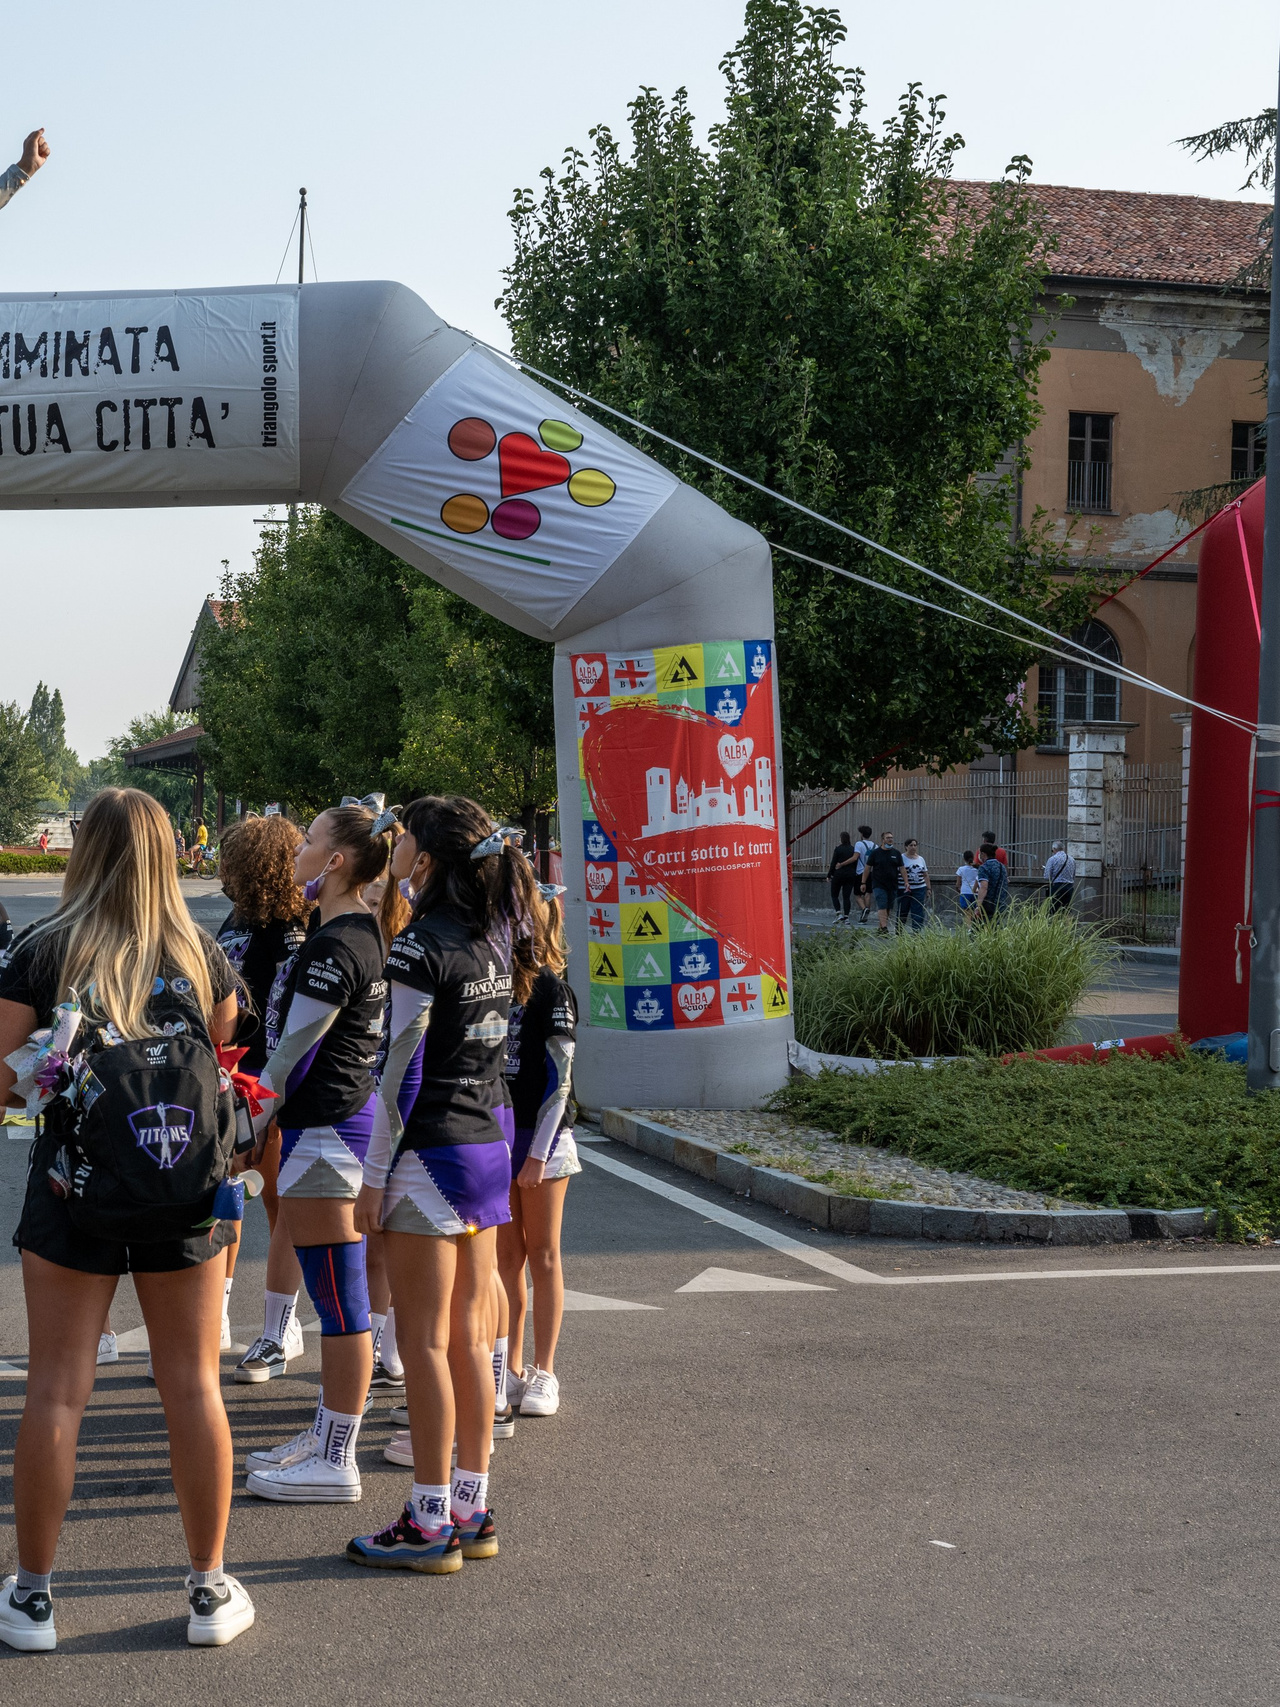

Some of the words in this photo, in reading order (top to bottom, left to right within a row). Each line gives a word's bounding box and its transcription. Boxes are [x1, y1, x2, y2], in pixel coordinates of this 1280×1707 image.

[261, 321, 279, 373] sport.it
[261, 375, 279, 448] triangolo
[578, 666, 598, 679] ALBA
[724, 744, 748, 760] ALBA
[643, 847, 685, 866] Corri
[690, 844, 729, 862] sotto
[733, 841, 745, 857] le
[748, 839, 773, 855] torri
[662, 861, 762, 877] WWW.TRIANGOLOSPORT.IT
[588, 872, 606, 884] ALBA
[386, 956, 411, 972] ERICA
[309, 978, 329, 991] GAIA
[683, 994, 708, 1006] ALBA
[330, 1424, 351, 1466] TITANS
